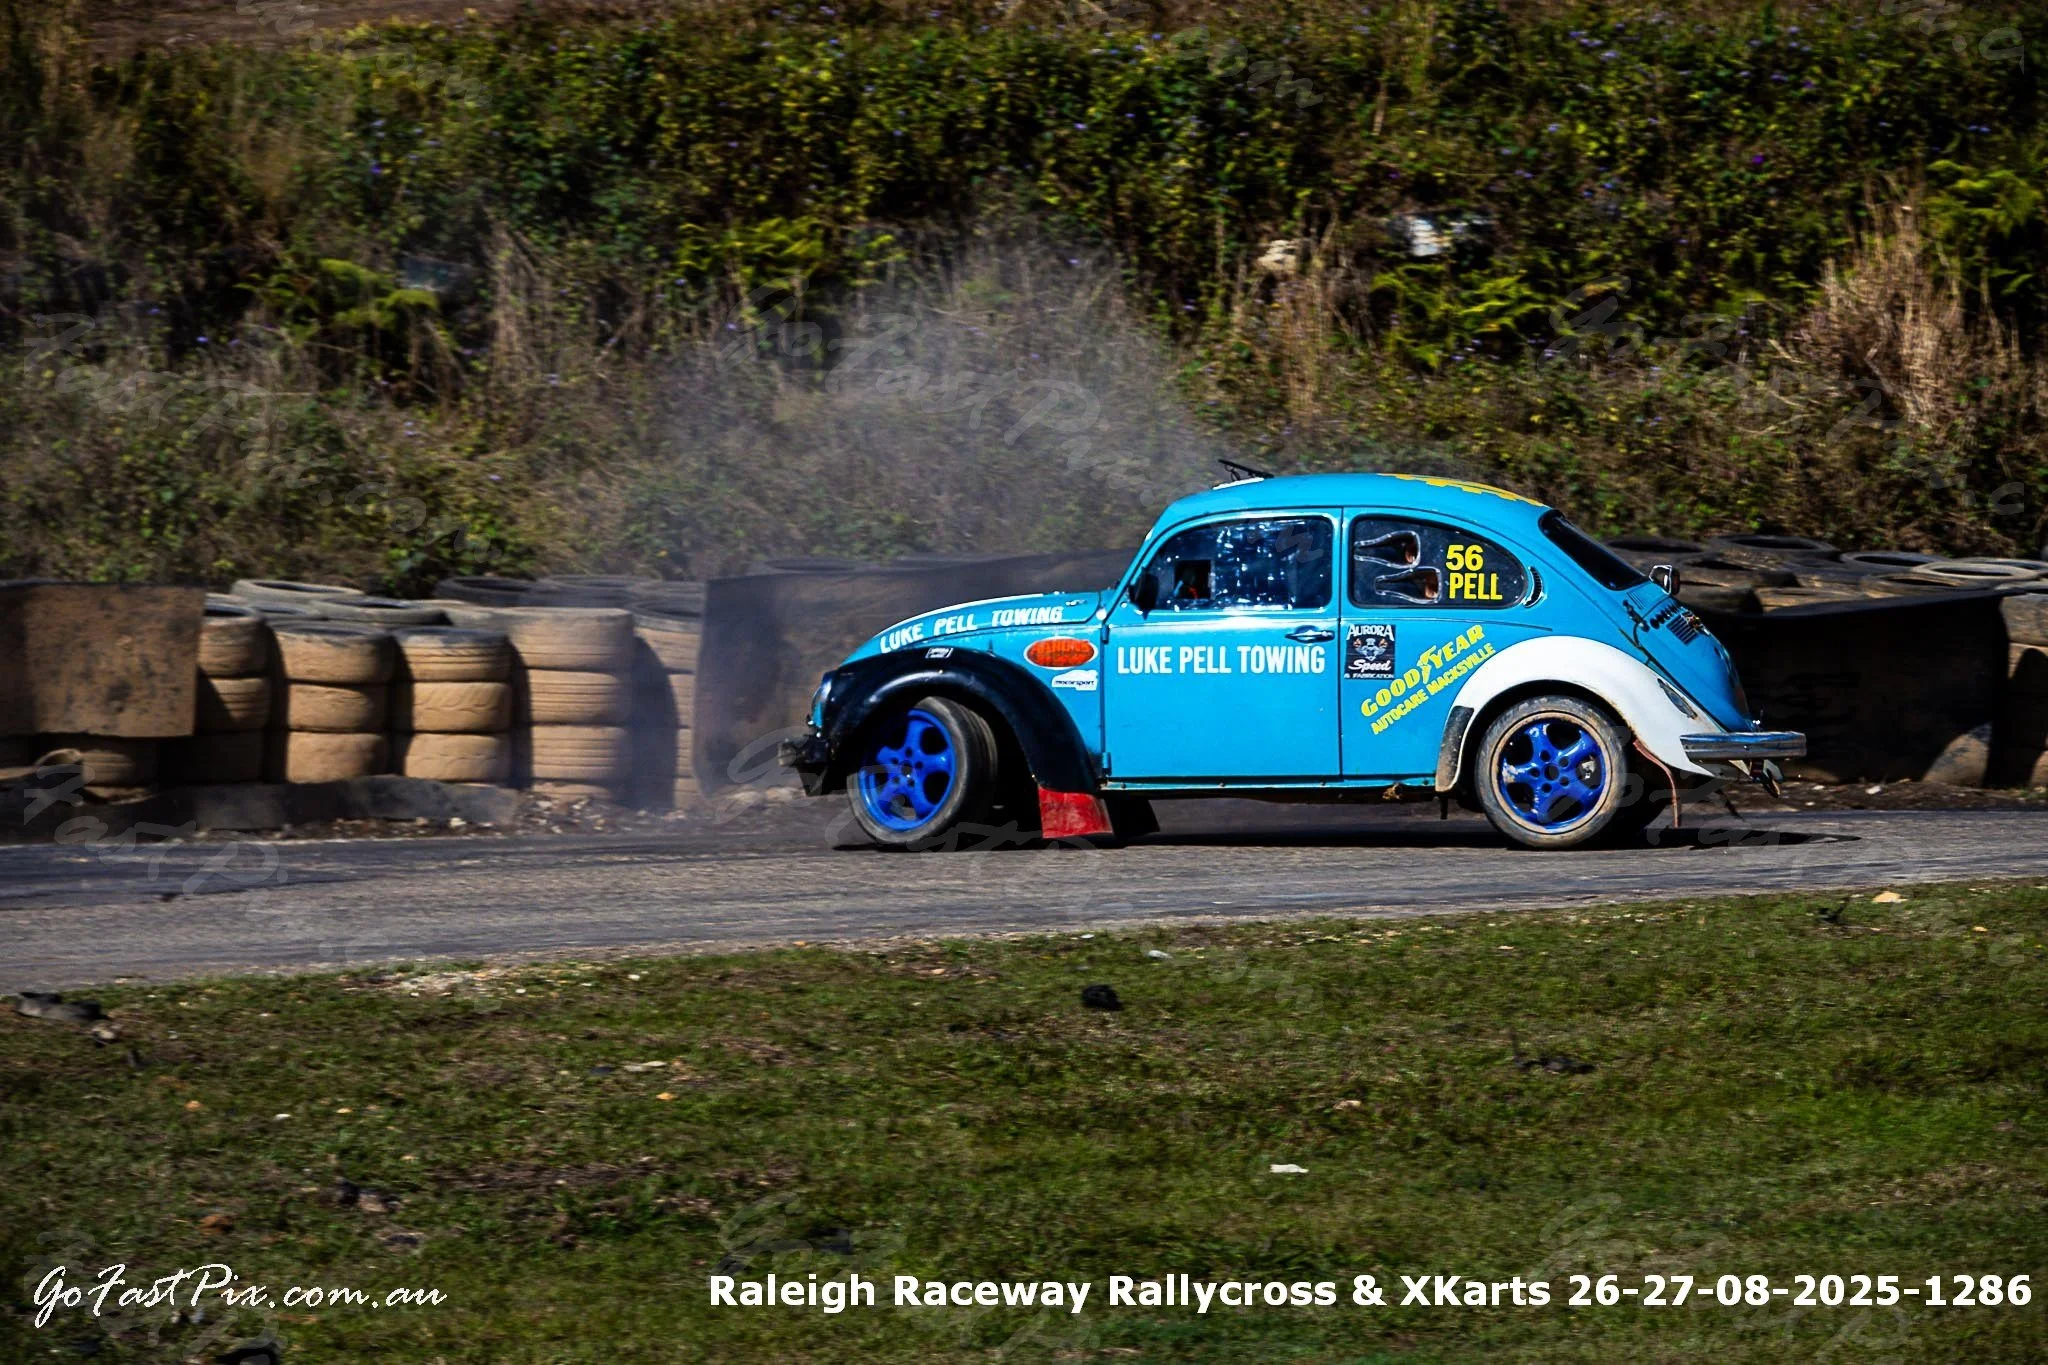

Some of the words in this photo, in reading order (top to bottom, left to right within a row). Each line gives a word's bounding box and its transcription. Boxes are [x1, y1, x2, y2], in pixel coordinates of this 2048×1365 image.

[1445, 544, 1484, 571] 56
[1449, 572, 1503, 600] PELL
[879, 622, 925, 654] LUKE
[933, 613, 978, 636] PELL
[991, 605, 1064, 627] TOWING
[1346, 624, 1395, 642] AURORA
[1117, 646, 1173, 675] LUKE
[1179, 646, 1232, 674] PELL
[1236, 645, 1326, 674] TOWING
[1348, 658, 1392, 673] Speed
[1360, 624, 1486, 717] GOODYEAR
[1370, 688, 1430, 736] AUTOCARE
[1426, 642, 1497, 696] MACKSVILLE
